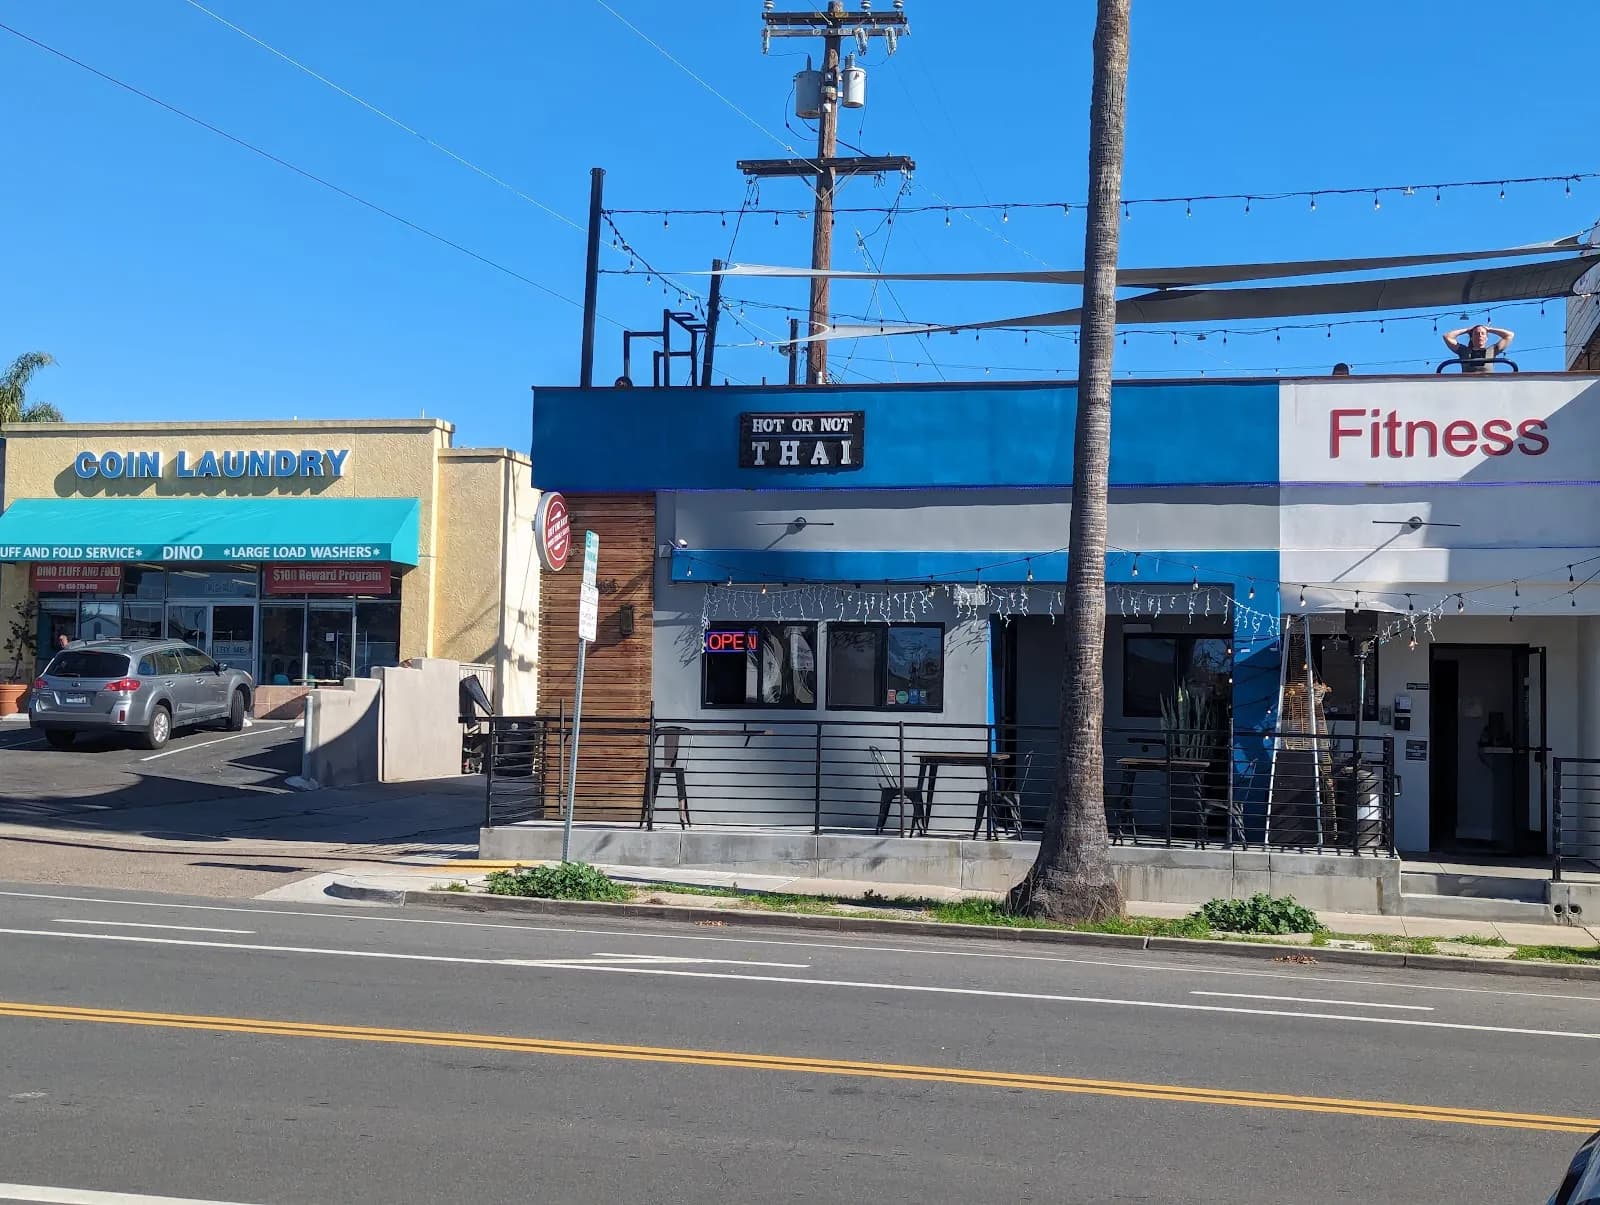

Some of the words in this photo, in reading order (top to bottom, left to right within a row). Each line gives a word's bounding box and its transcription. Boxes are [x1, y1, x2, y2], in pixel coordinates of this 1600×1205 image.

[752, 418, 785, 433] HOT
[791, 418, 814, 432] OR
[820, 417, 853, 432] NOT
[1329, 408, 1549, 459] Fitness
[751, 440, 852, 466] THAI
[74, 450, 164, 479] COIN
[176, 449, 352, 478] LAUNDRY
[23, 546, 50, 559] AND
[52, 546, 83, 559] FOLD
[162, 545, 204, 560] DINO
[273, 546, 306, 559] LOAD
[36, 566, 57, 577] DINO
[58, 566, 81, 577] FLUFF
[82, 566, 99, 577] AND
[100, 566, 121, 577] FOLD
[299, 568, 337, 581] Reward
[338, 568, 382, 583] Program
[709, 633, 758, 650] OPEN
